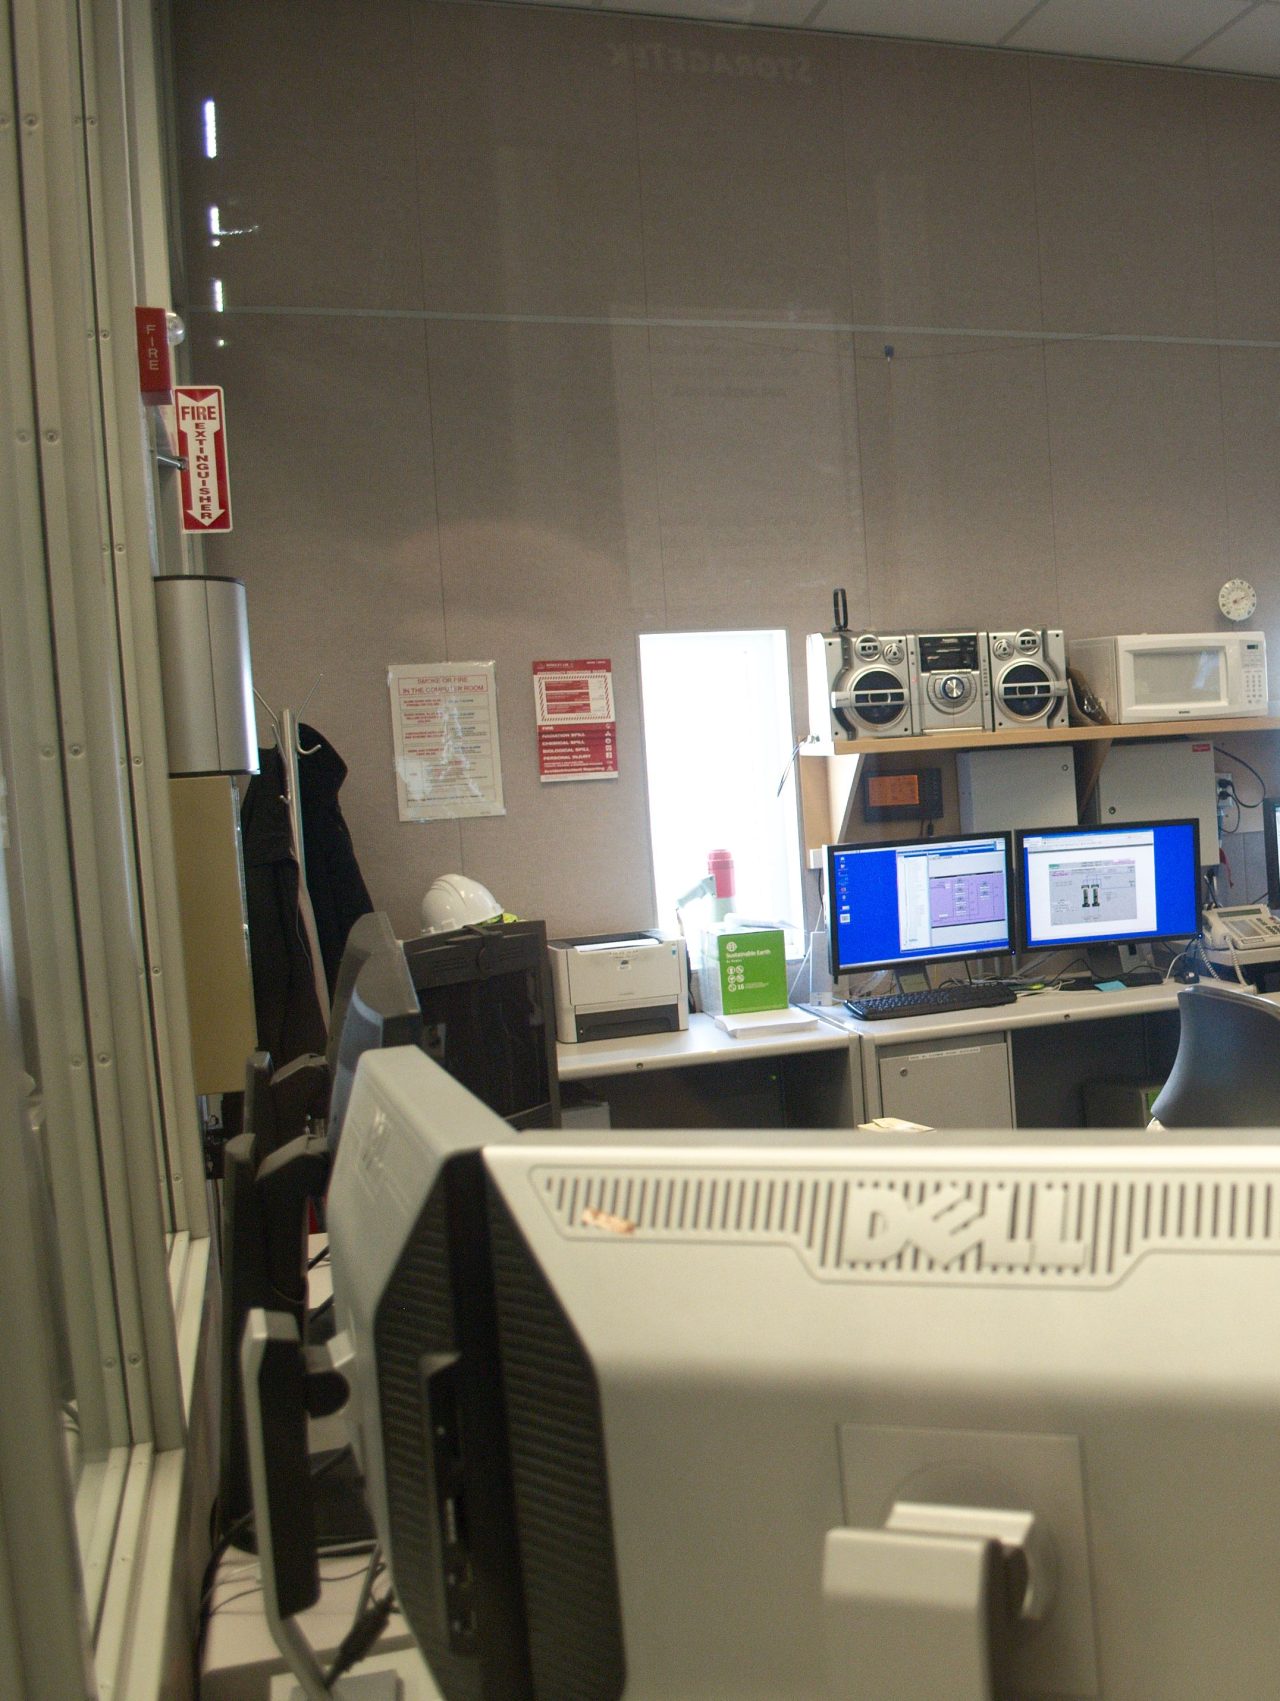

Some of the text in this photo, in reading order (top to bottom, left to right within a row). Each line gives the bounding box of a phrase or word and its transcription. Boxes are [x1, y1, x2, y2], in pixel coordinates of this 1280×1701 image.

[146, 324, 159, 371] FIRE
[181, 405, 217, 421] FIRE
[194, 422, 213, 520] EXTINGUISHER
[844, 1182, 1089, 1270] DELL
